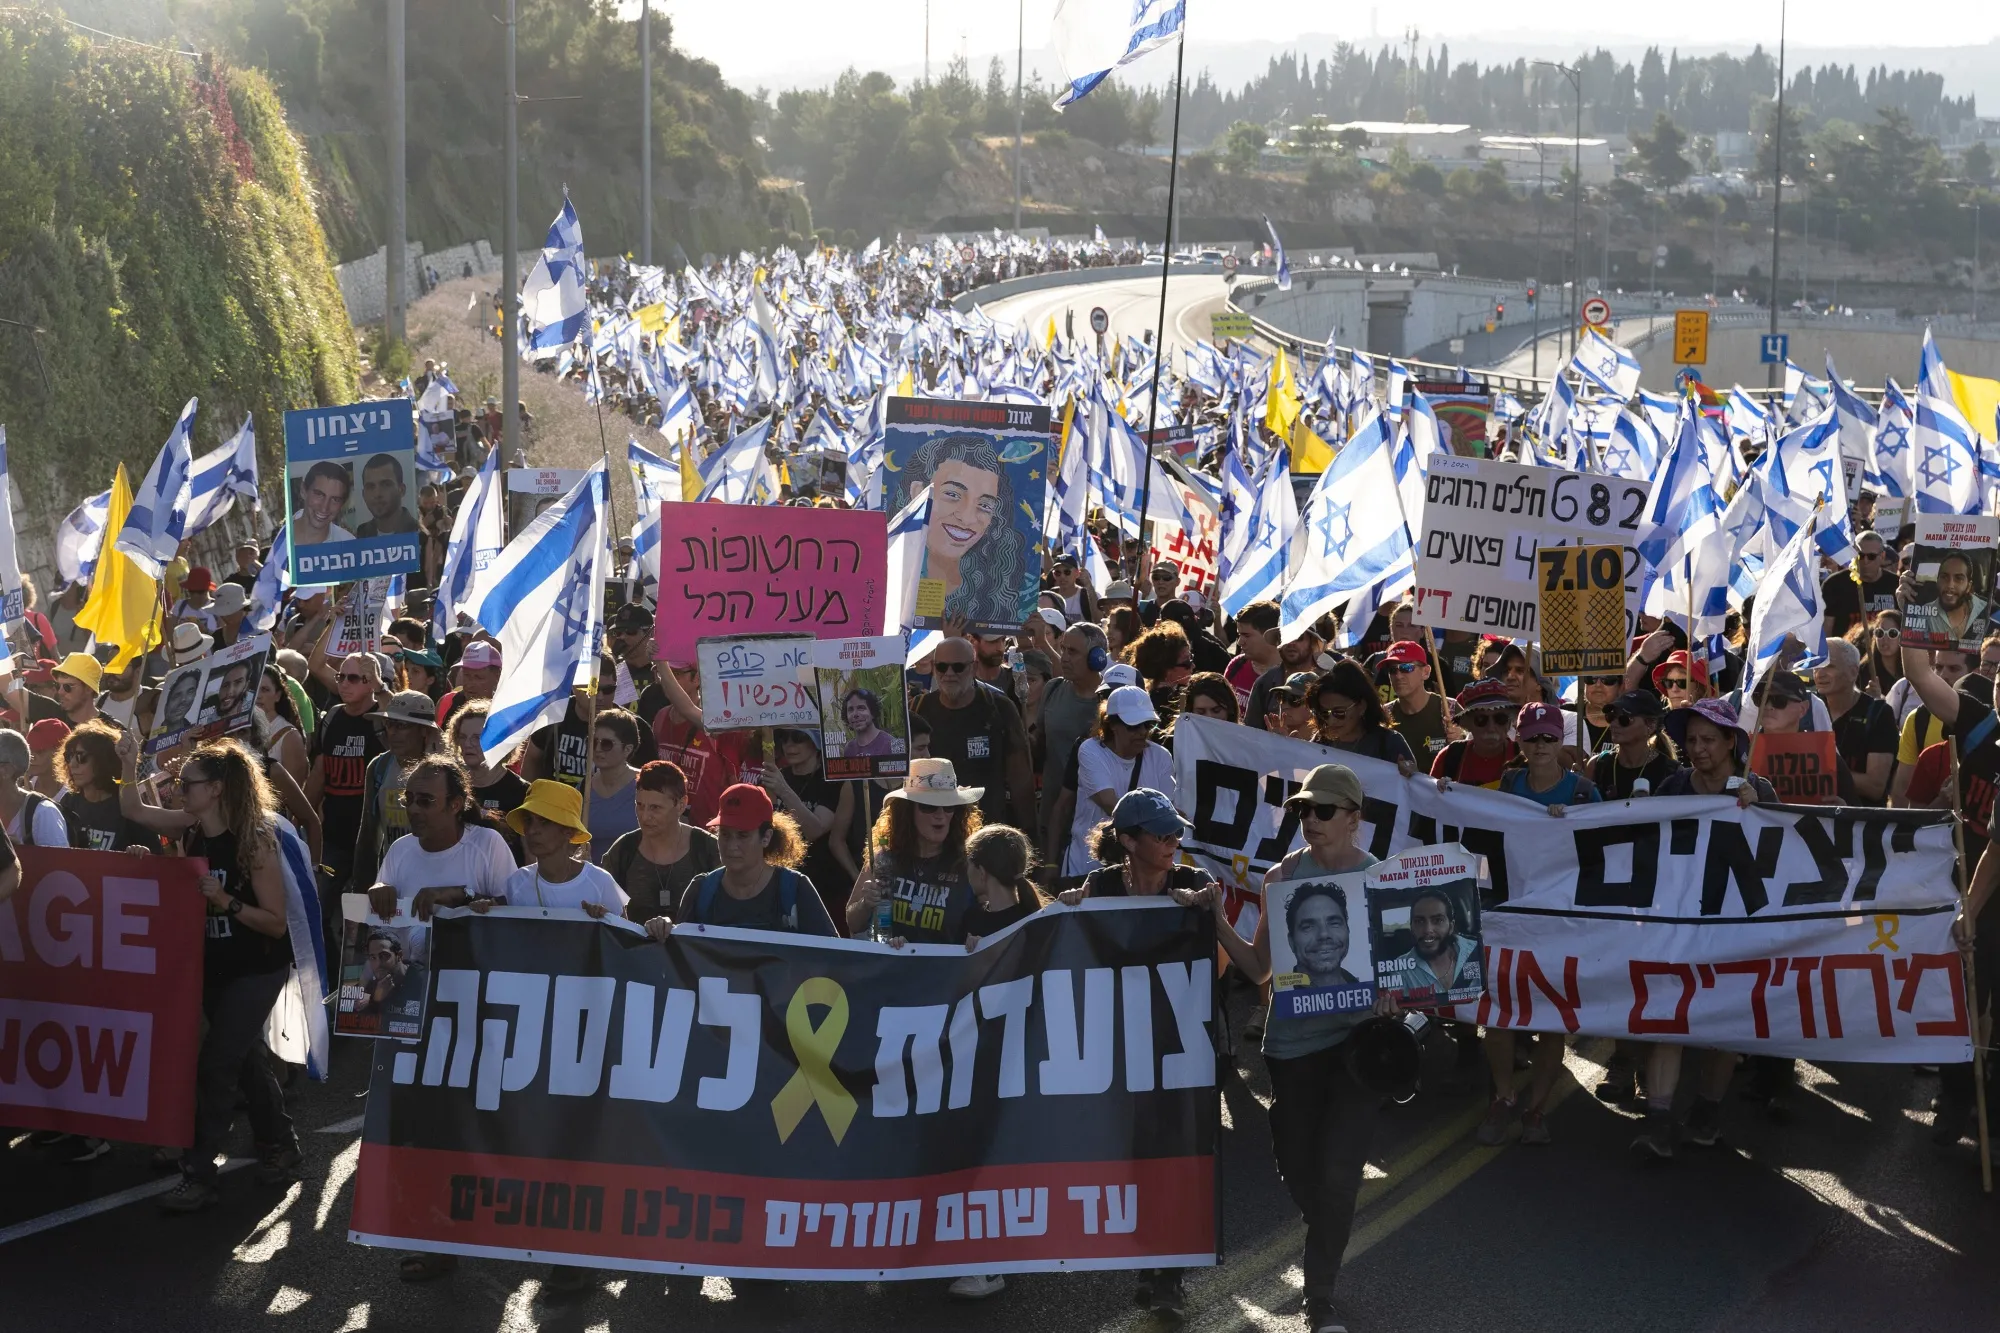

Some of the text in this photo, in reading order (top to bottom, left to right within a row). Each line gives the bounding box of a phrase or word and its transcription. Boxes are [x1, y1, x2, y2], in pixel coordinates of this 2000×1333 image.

[1008, 409, 1033, 425] ארבל
[307, 410, 391, 444] ניצחון
[1428, 475, 1487, 509] הרוגים
[1925, 533, 1991, 543] MATAN ZANGAUKER
[676, 527, 861, 574] החטופות
[1426, 530, 1504, 567] פצועים
[299, 544, 416, 573] השבת הבנים
[1540, 548, 1622, 592] 7.10
[684, 576, 849, 625] מעל הכל
[1906, 604, 1939, 617] BRING
[1905, 617, 1926, 629] HIM
[716, 645, 765, 670] כולם
[839, 650, 876, 660] OFER KALDERON
[721, 681, 806, 718] עכשיו!
[759, 712, 777, 721] חיים
[789, 711, 813, 723] עסקה
[155, 732, 181, 751] BRING
[824, 732, 847, 745] BRING
[826, 745, 841, 758] HIM
[968, 748, 990, 758] לנשק
[1767, 753, 1820, 775] כולנו
[1759, 774, 1834, 796] חטופי
[1430, 854, 1445, 866] מתן
[1573, 815, 1921, 916] יוצאים
[1380, 865, 1467, 883] MATAN ZANGAUKER
[1415, 877, 1431, 886] (24)
[920, 906, 945, 931] הם
[1377, 957, 1417, 973] BRING
[1378, 974, 1404, 988] HIM
[342, 985, 365, 999] BRING
[1292, 988, 1373, 1014] BRING OFER
[1628, 952, 1970, 1039] מחזירים
[339, 999, 355, 1012] HIM
[392, 958, 1216, 1118] צועדות לעסקה
[450, 1173, 1138, 1248] עד שהם חוזרים כולנו חטופים
